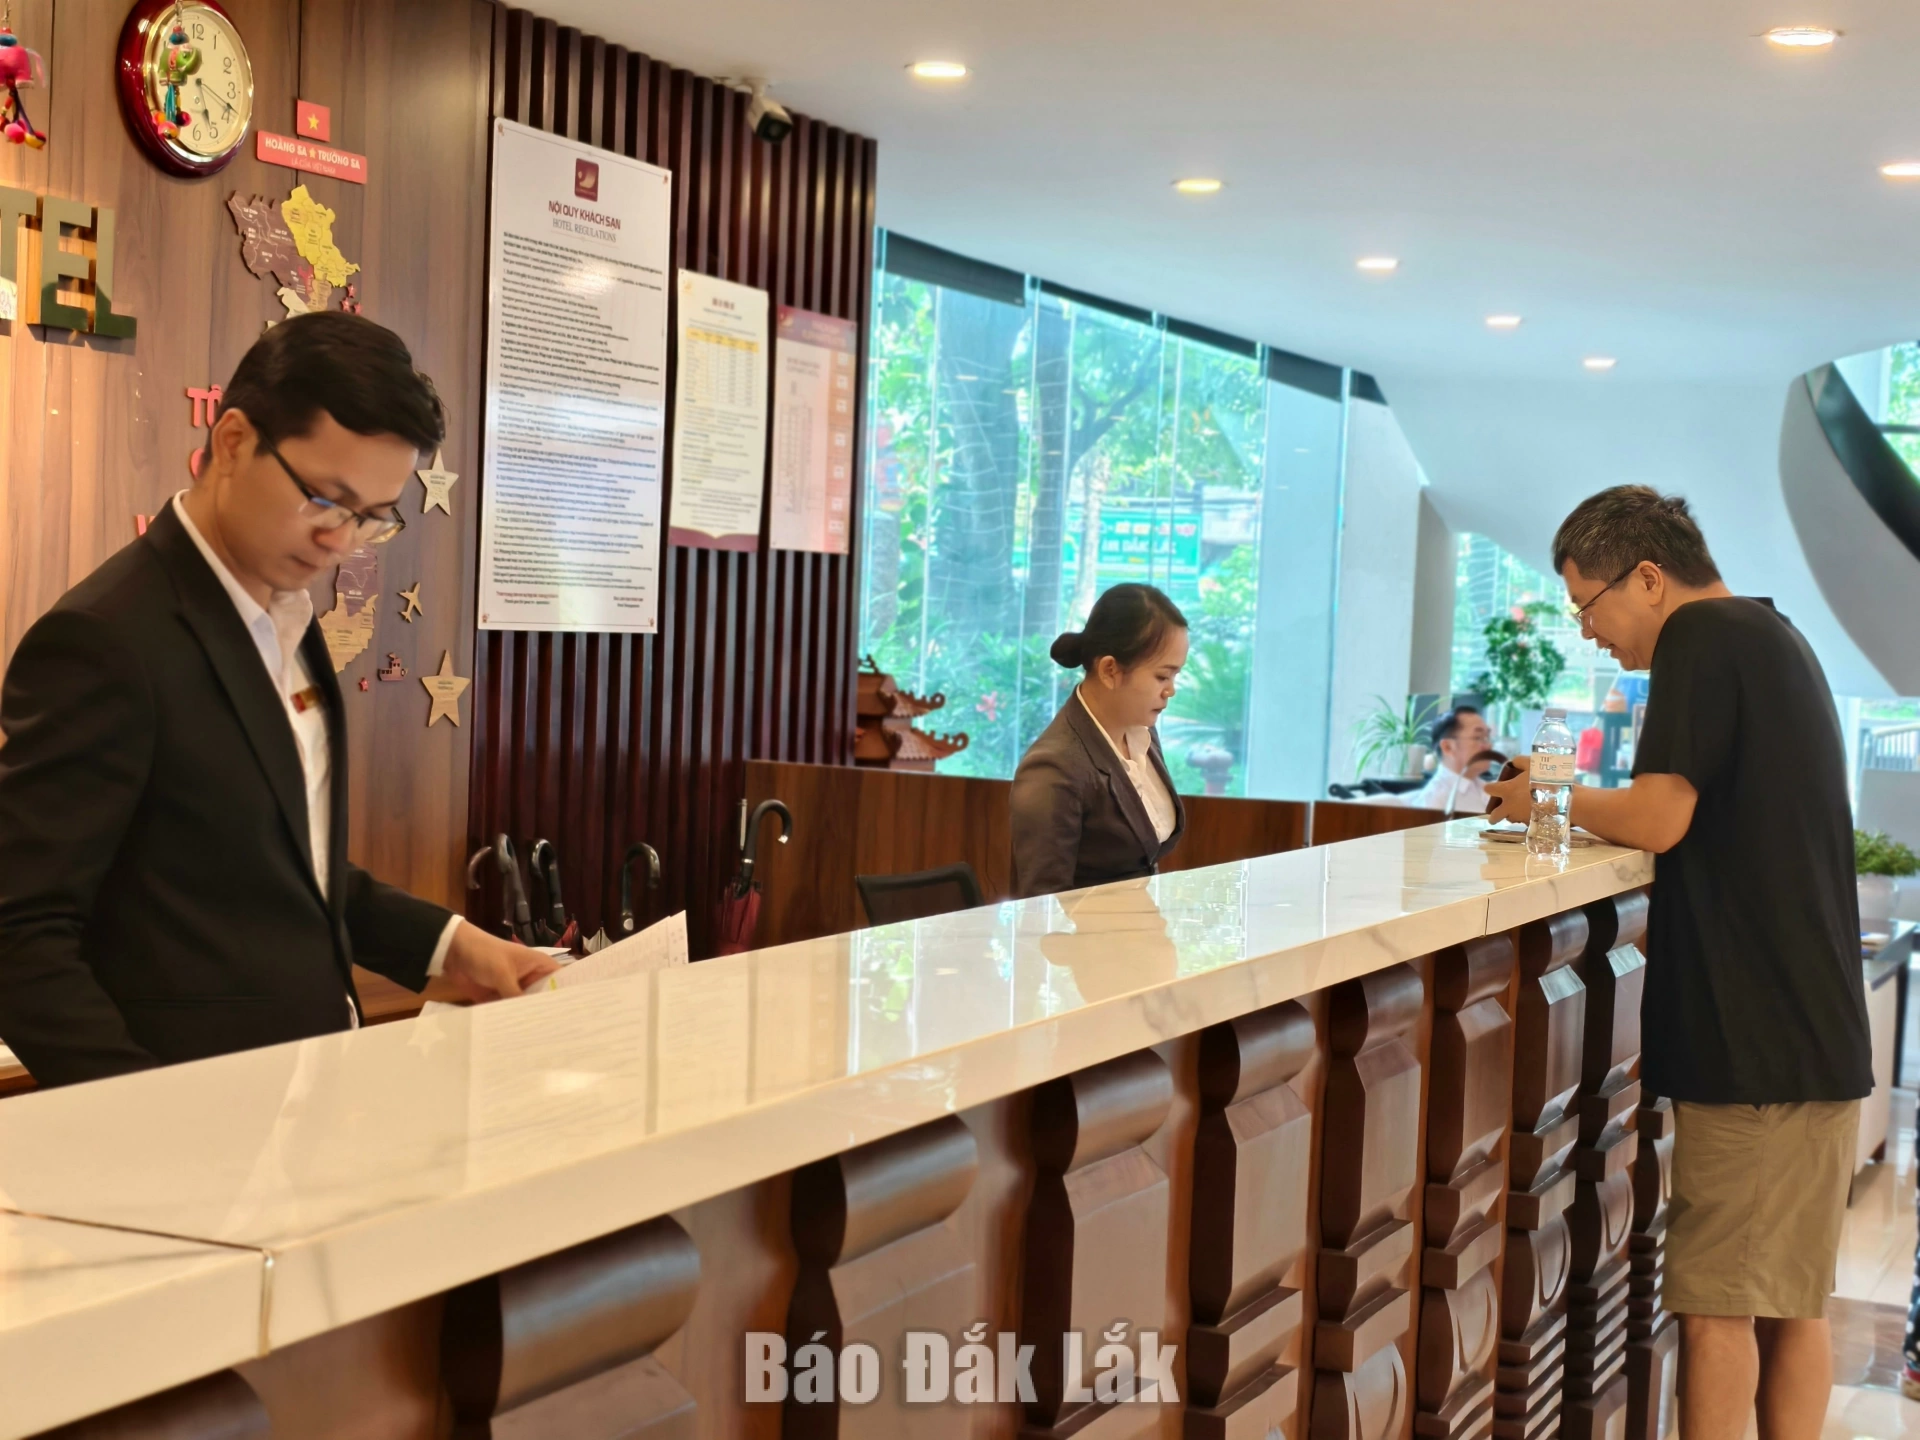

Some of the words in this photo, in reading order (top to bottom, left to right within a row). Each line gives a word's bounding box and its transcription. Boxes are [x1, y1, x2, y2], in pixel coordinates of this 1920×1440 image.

[192, 23, 204, 41] 12
[223, 56, 232, 75] 2
[226, 81, 236, 100] 3
[192, 123, 202, 141] 6
[209, 121, 219, 139] 5
[265, 136, 296, 154] HOÀNG
[297, 145, 308, 157] SA
[350, 158, 361, 170] SA
[562, 205, 579, 218] QUY
[552, 218, 573, 233] HOTEL
[574, 223, 617, 243] REGULATIONS
[1539, 762, 1557, 771] true
